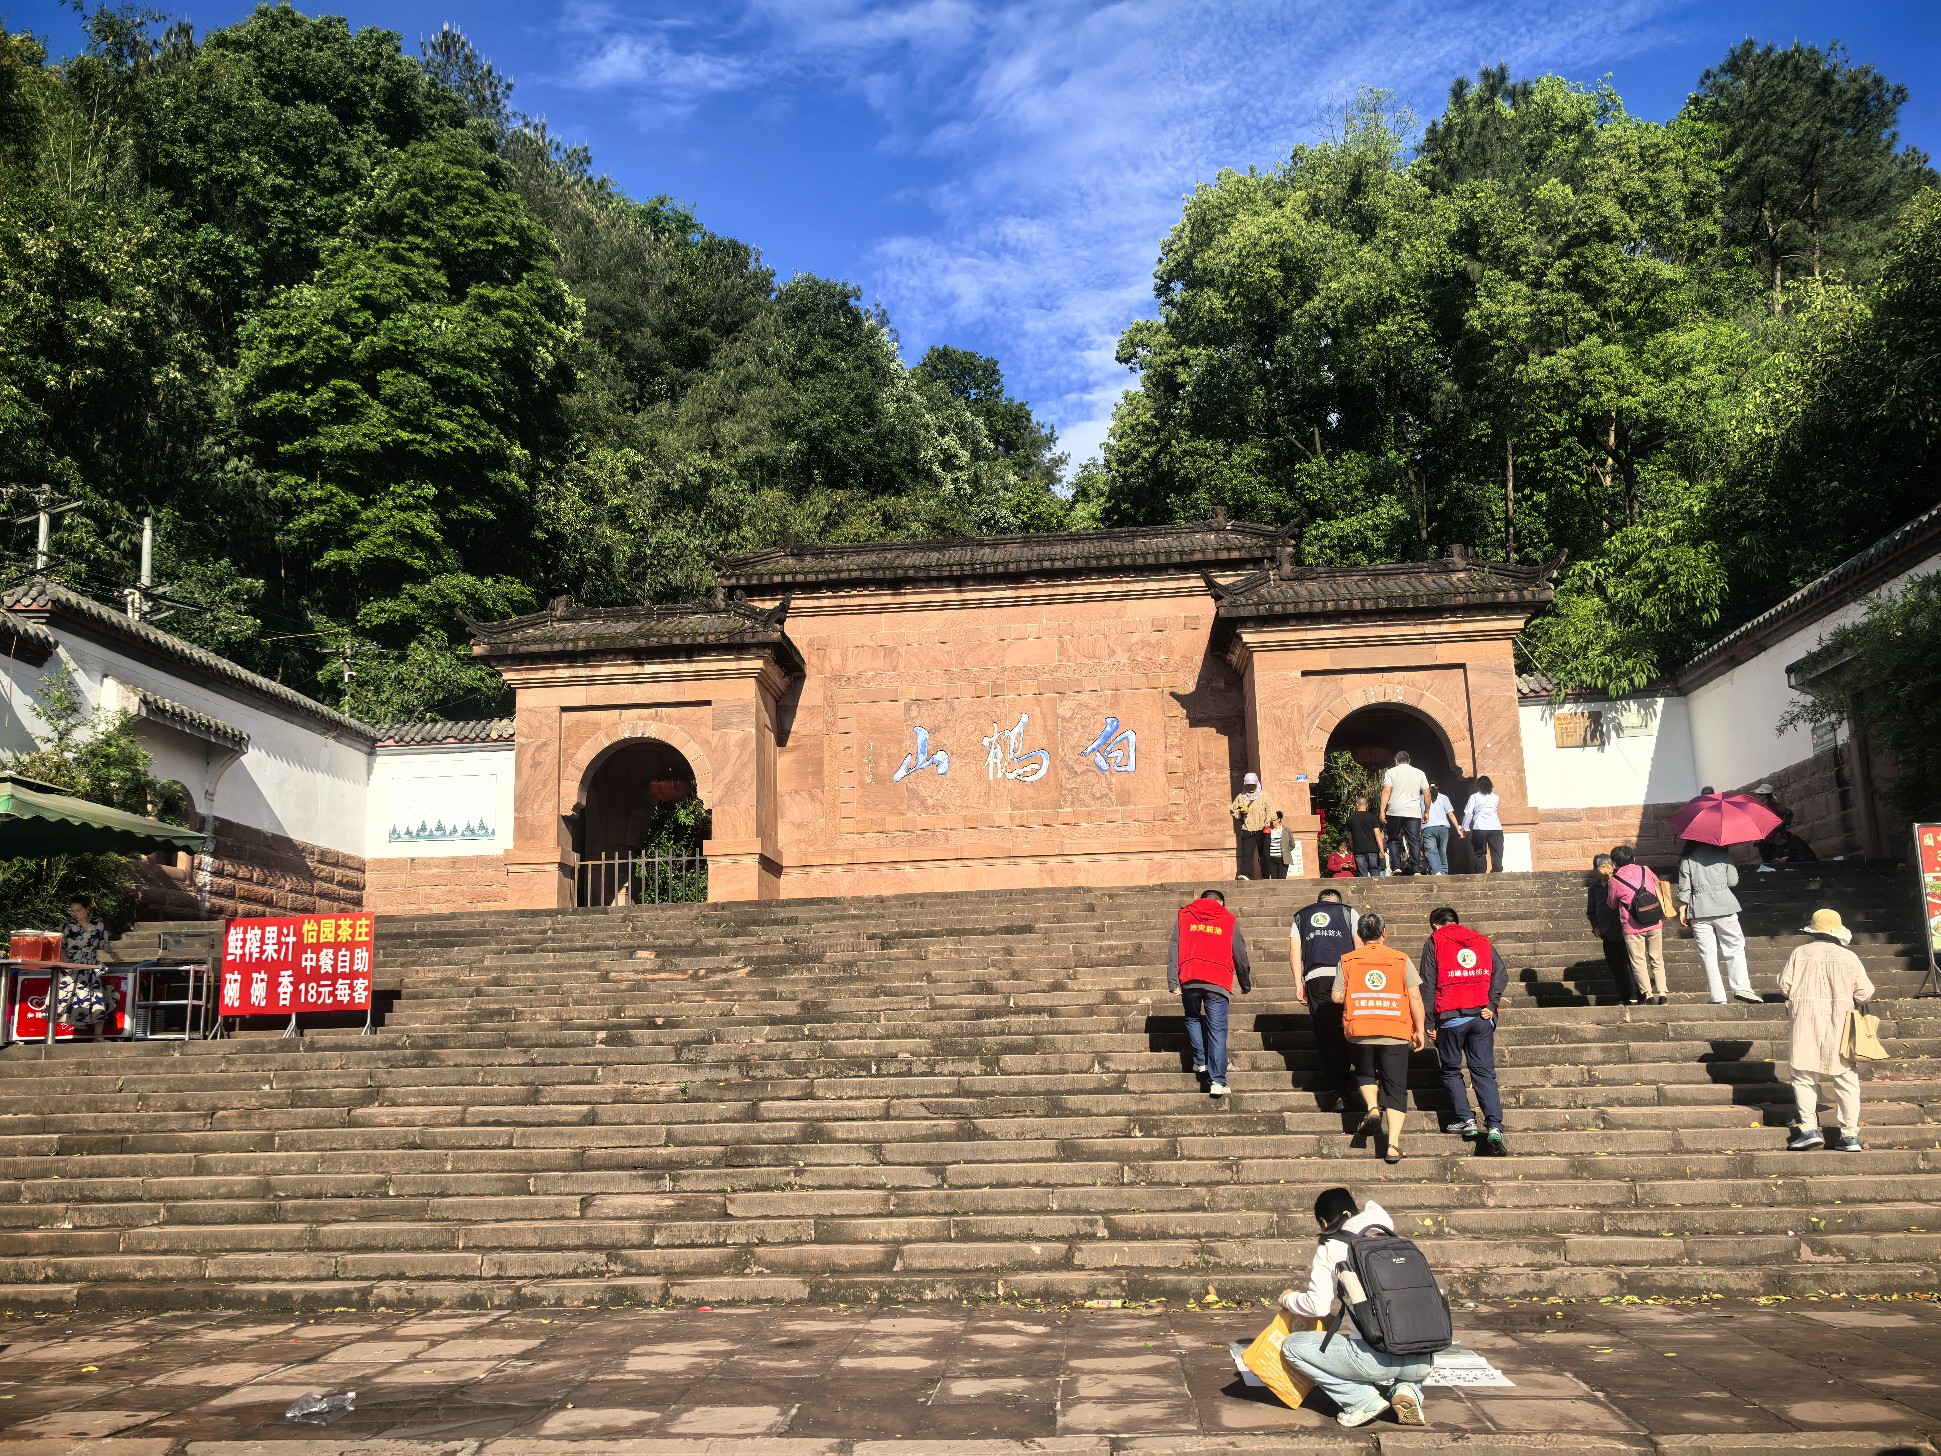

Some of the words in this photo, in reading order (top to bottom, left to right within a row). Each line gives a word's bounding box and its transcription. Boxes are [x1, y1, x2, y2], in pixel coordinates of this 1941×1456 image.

[226, 924, 297, 963] 鲜榨果汁
[302, 917, 371, 944] 怡园茶庄
[301, 946, 370, 975] 中餐自助
[298, 978, 369, 1005] 18元每客
